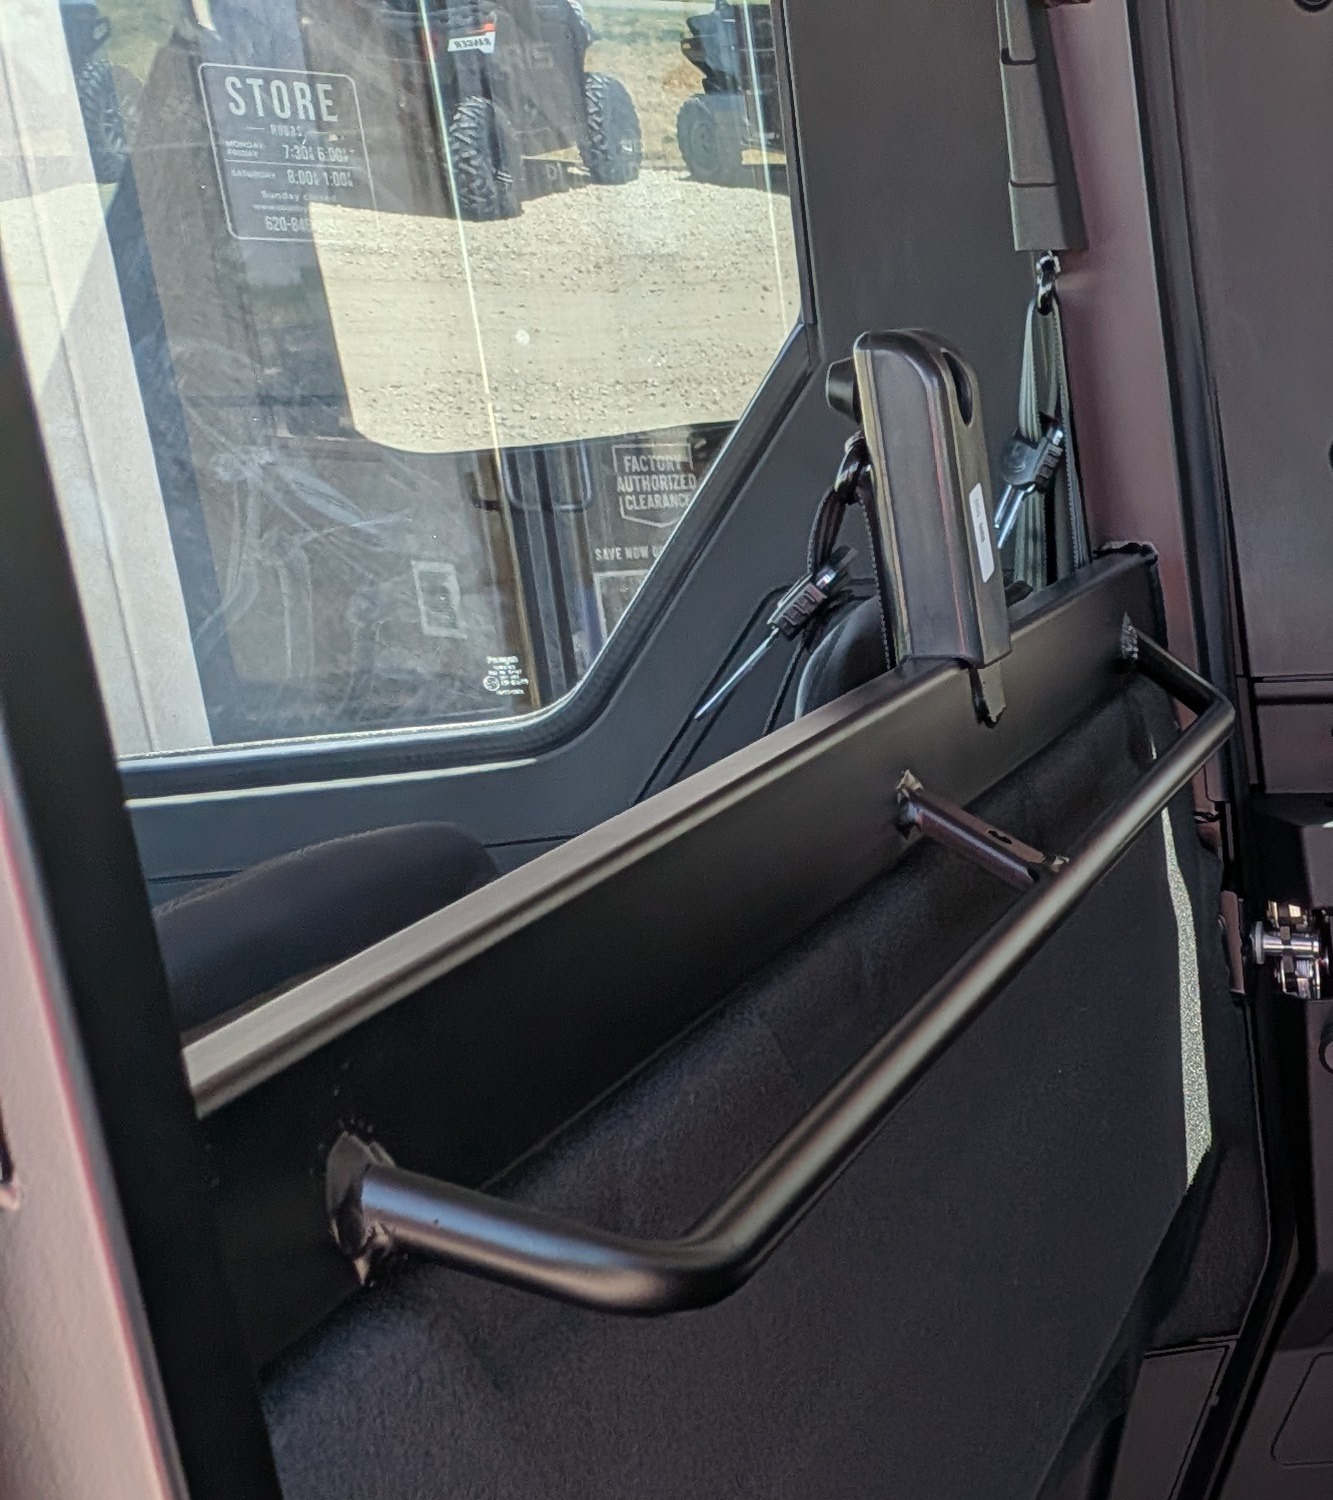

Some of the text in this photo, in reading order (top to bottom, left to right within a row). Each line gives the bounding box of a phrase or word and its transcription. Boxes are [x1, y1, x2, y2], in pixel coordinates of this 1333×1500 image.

[224, 76, 338, 122] STORE
[622, 455, 682, 473] FACTORY
[616, 473, 697, 493] AUTHORIZED
[624, 493, 691, 511] CLEARANC
[594, 547, 622, 561] SAVE
